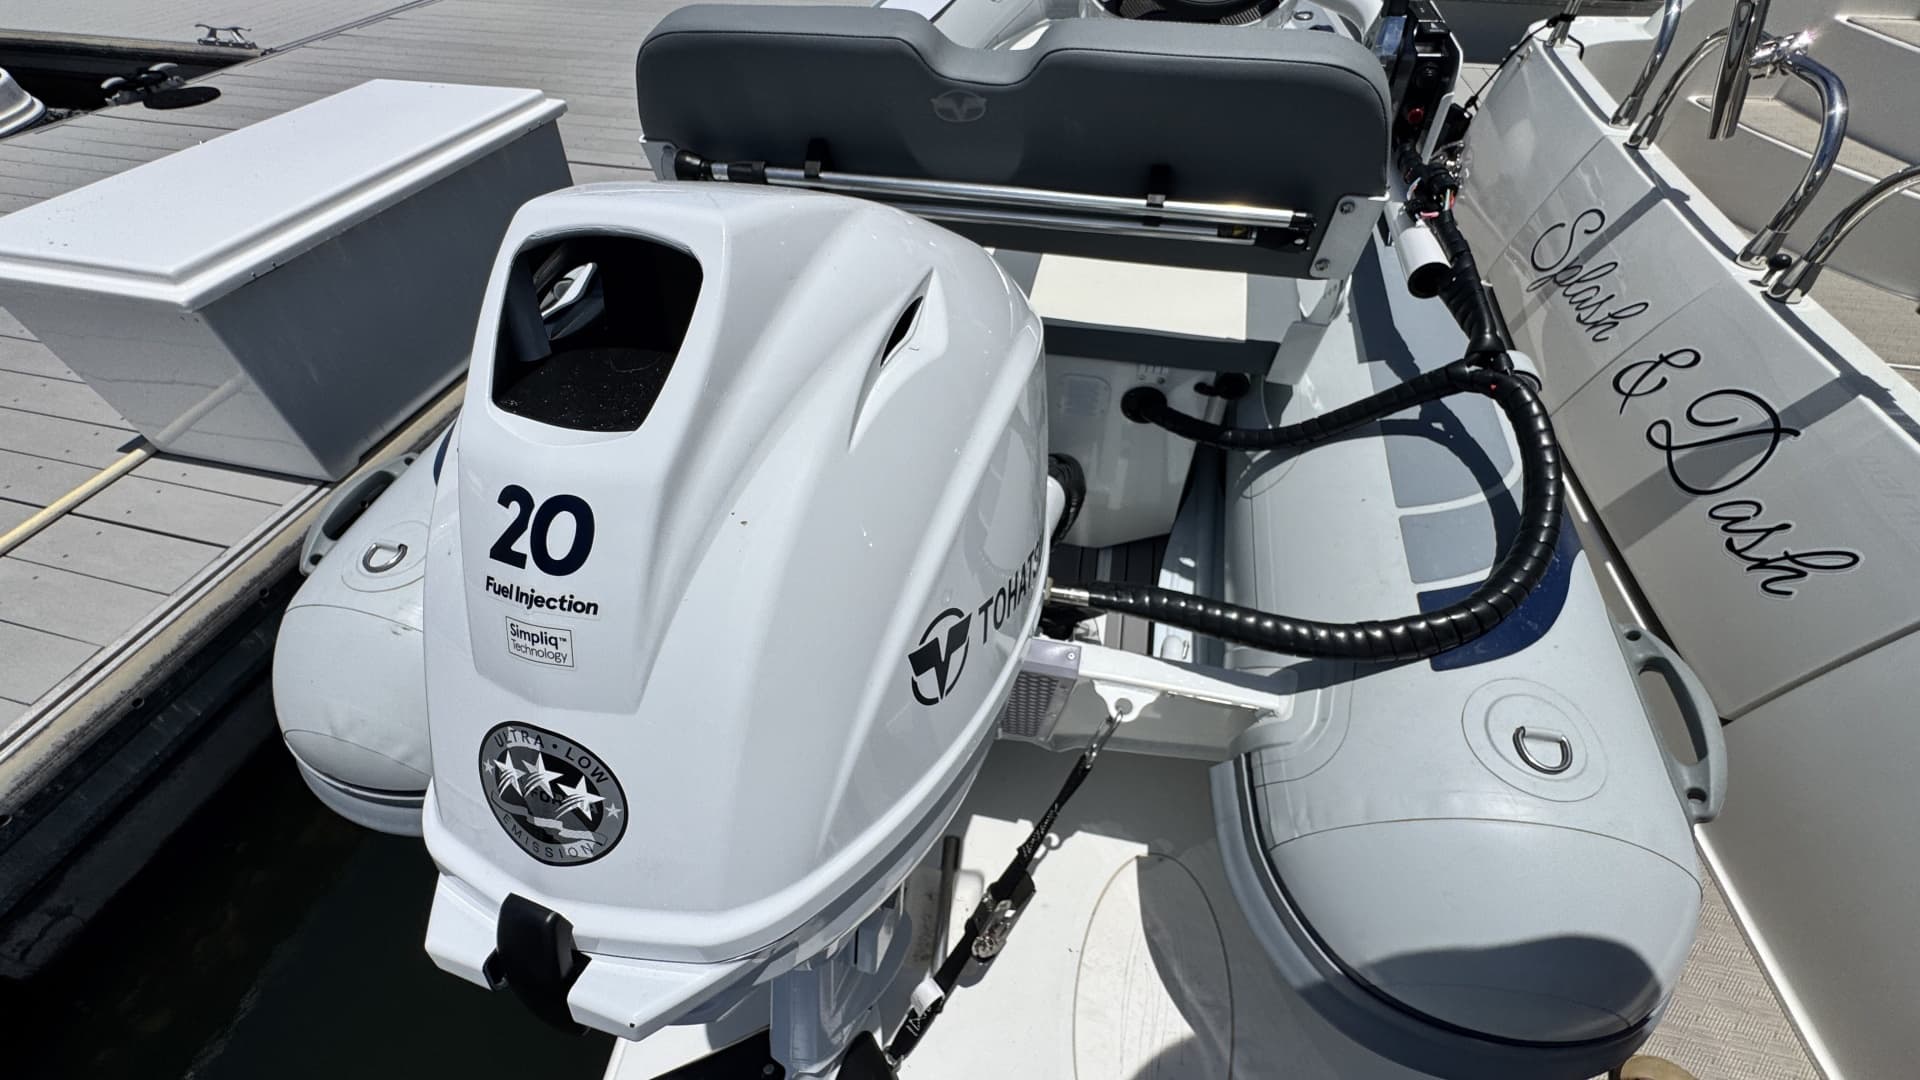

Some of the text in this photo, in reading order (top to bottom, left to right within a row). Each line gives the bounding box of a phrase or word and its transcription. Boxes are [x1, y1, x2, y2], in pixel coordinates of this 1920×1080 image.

[1526, 208, 1860, 596] Splash & Dash
[489, 484, 595, 576] 20
[486, 575, 599, 616] Fuel Injection
[511, 638, 568, 664] Technology
[494, 729, 609, 785] ULTRA LOW
[503, 813, 595, 860] EMISSION
